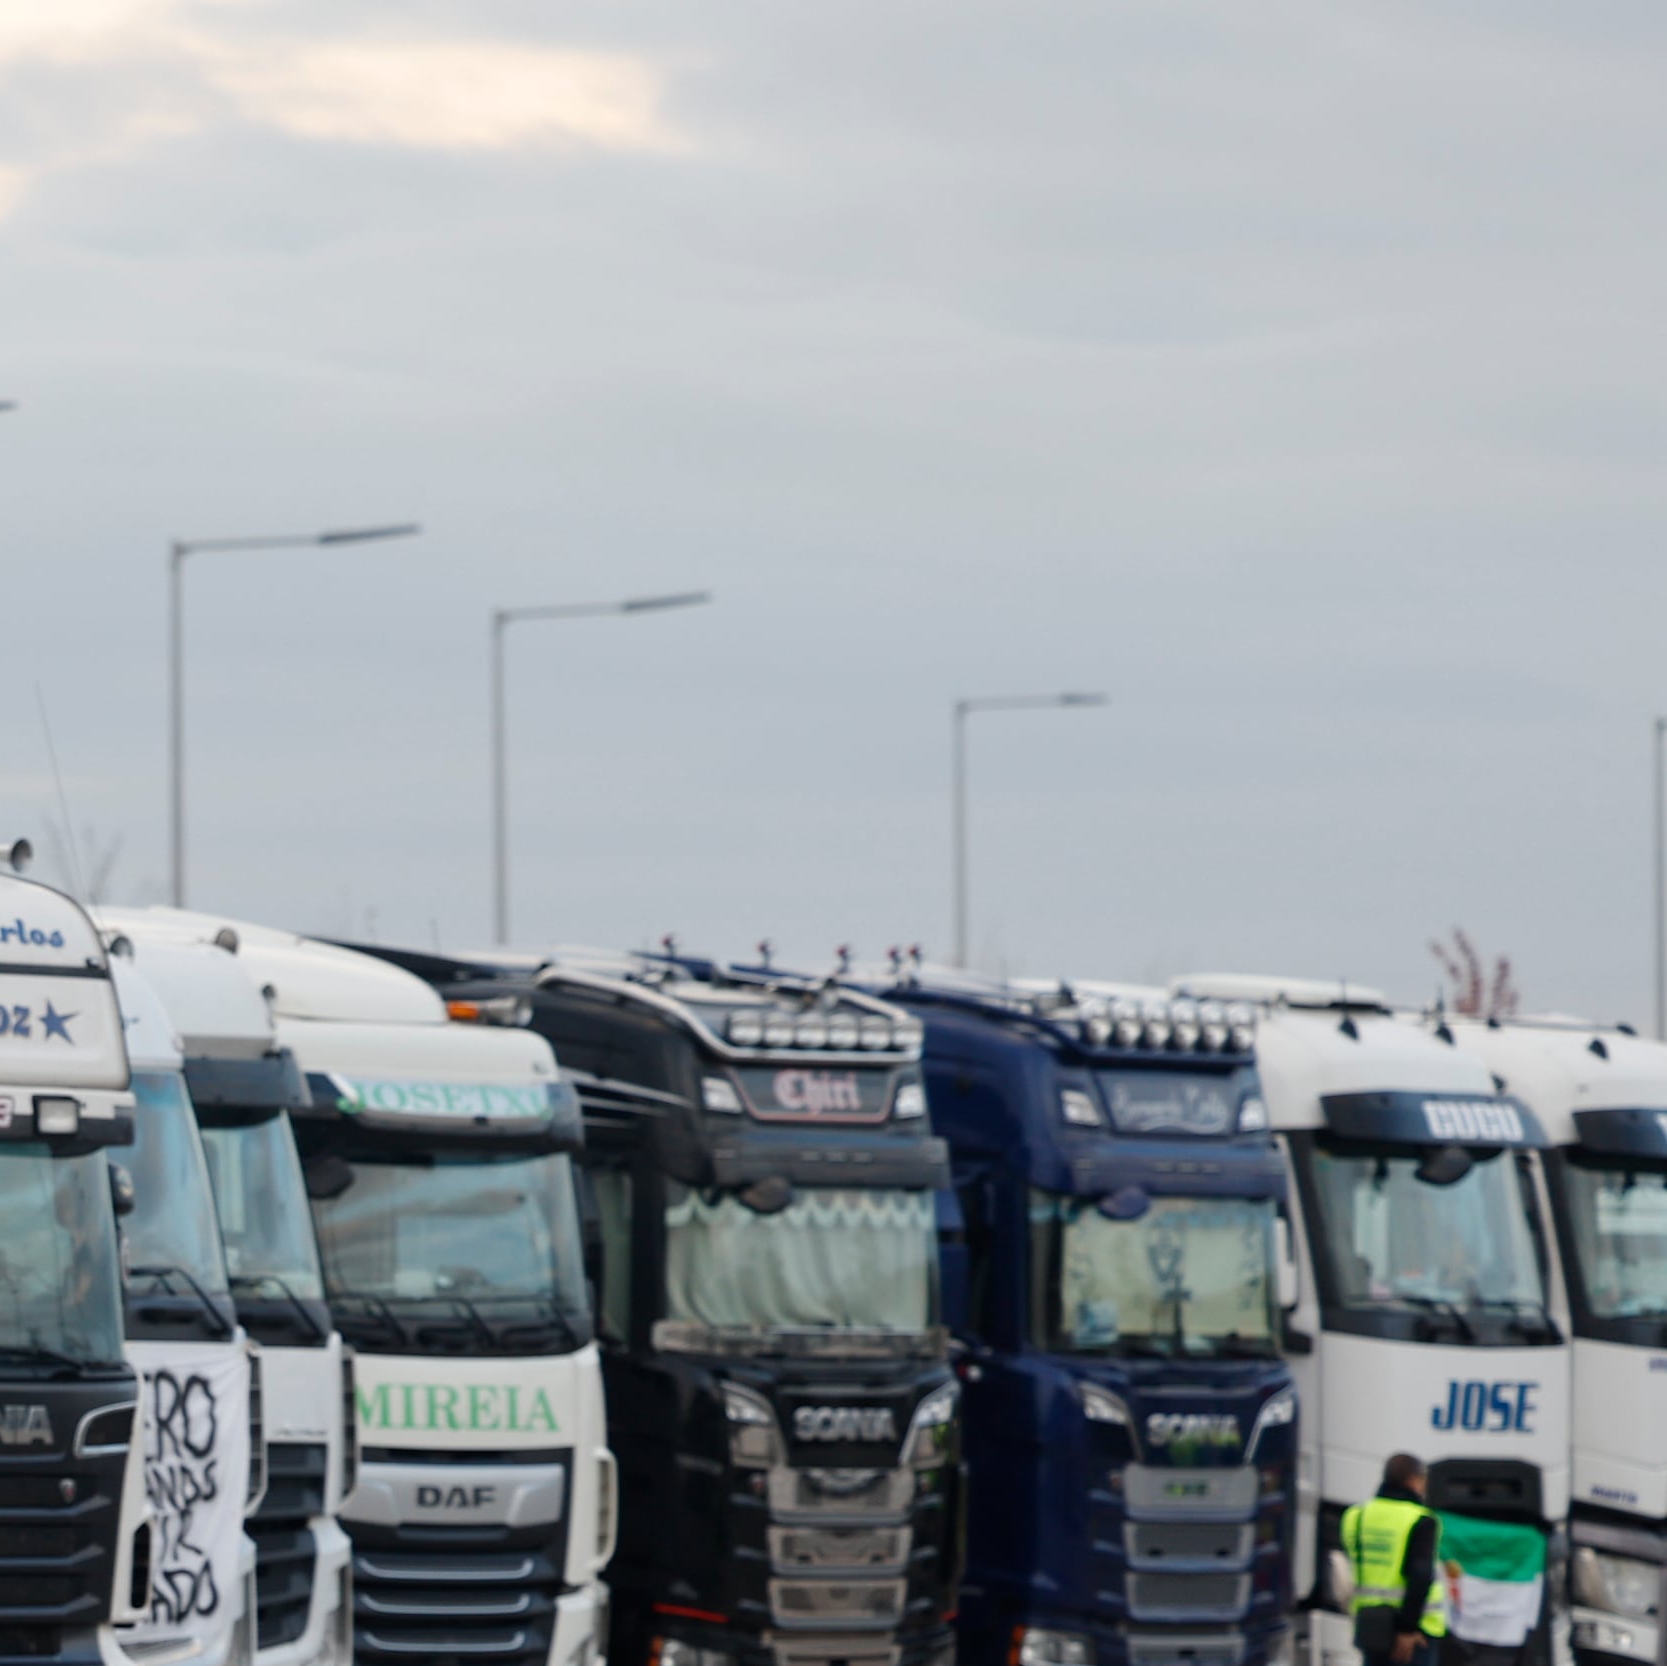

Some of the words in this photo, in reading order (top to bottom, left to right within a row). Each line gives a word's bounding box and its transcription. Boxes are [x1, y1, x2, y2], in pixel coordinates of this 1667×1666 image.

[144, 1370, 216, 1457] RO
[353, 1382, 560, 1432] MIREIA
[794, 1406, 896, 1441] SCANIA
[1432, 1380, 1538, 1433] JOSE
[416, 1486, 496, 1508] DAF
